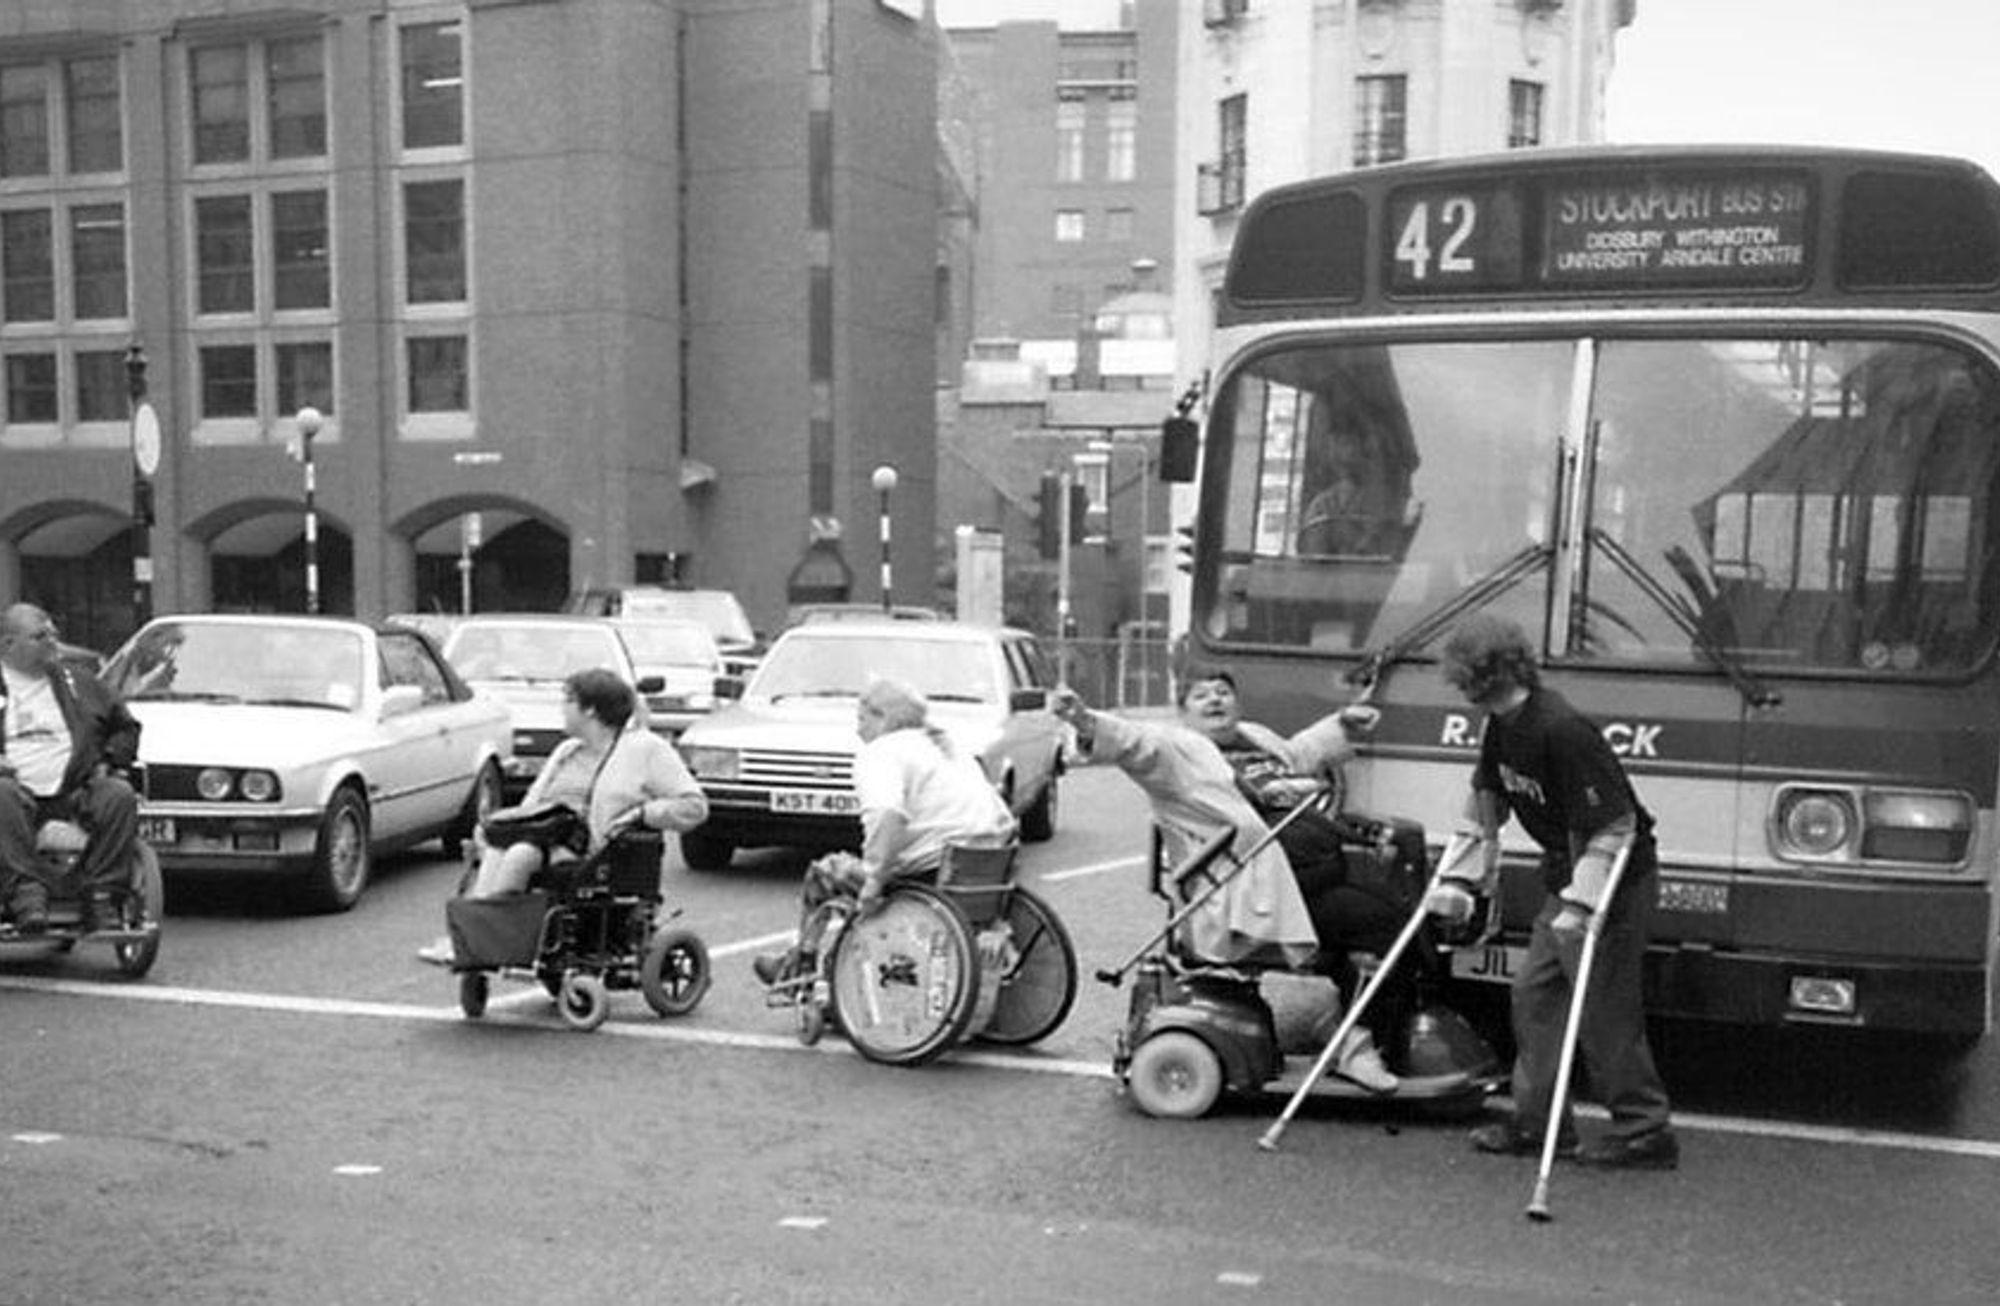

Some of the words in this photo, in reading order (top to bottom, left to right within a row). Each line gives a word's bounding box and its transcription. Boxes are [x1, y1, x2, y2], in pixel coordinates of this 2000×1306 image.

[1560, 186, 1710, 223] STOCKPORT
[1721, 187, 1763, 213] BUS
[1395, 198, 1477, 279] 42
[1675, 226, 1780, 247] WITHINGTON
[1558, 250, 1650, 270] UNIVERSITY
[1661, 248, 1732, 268] ARNDALE
